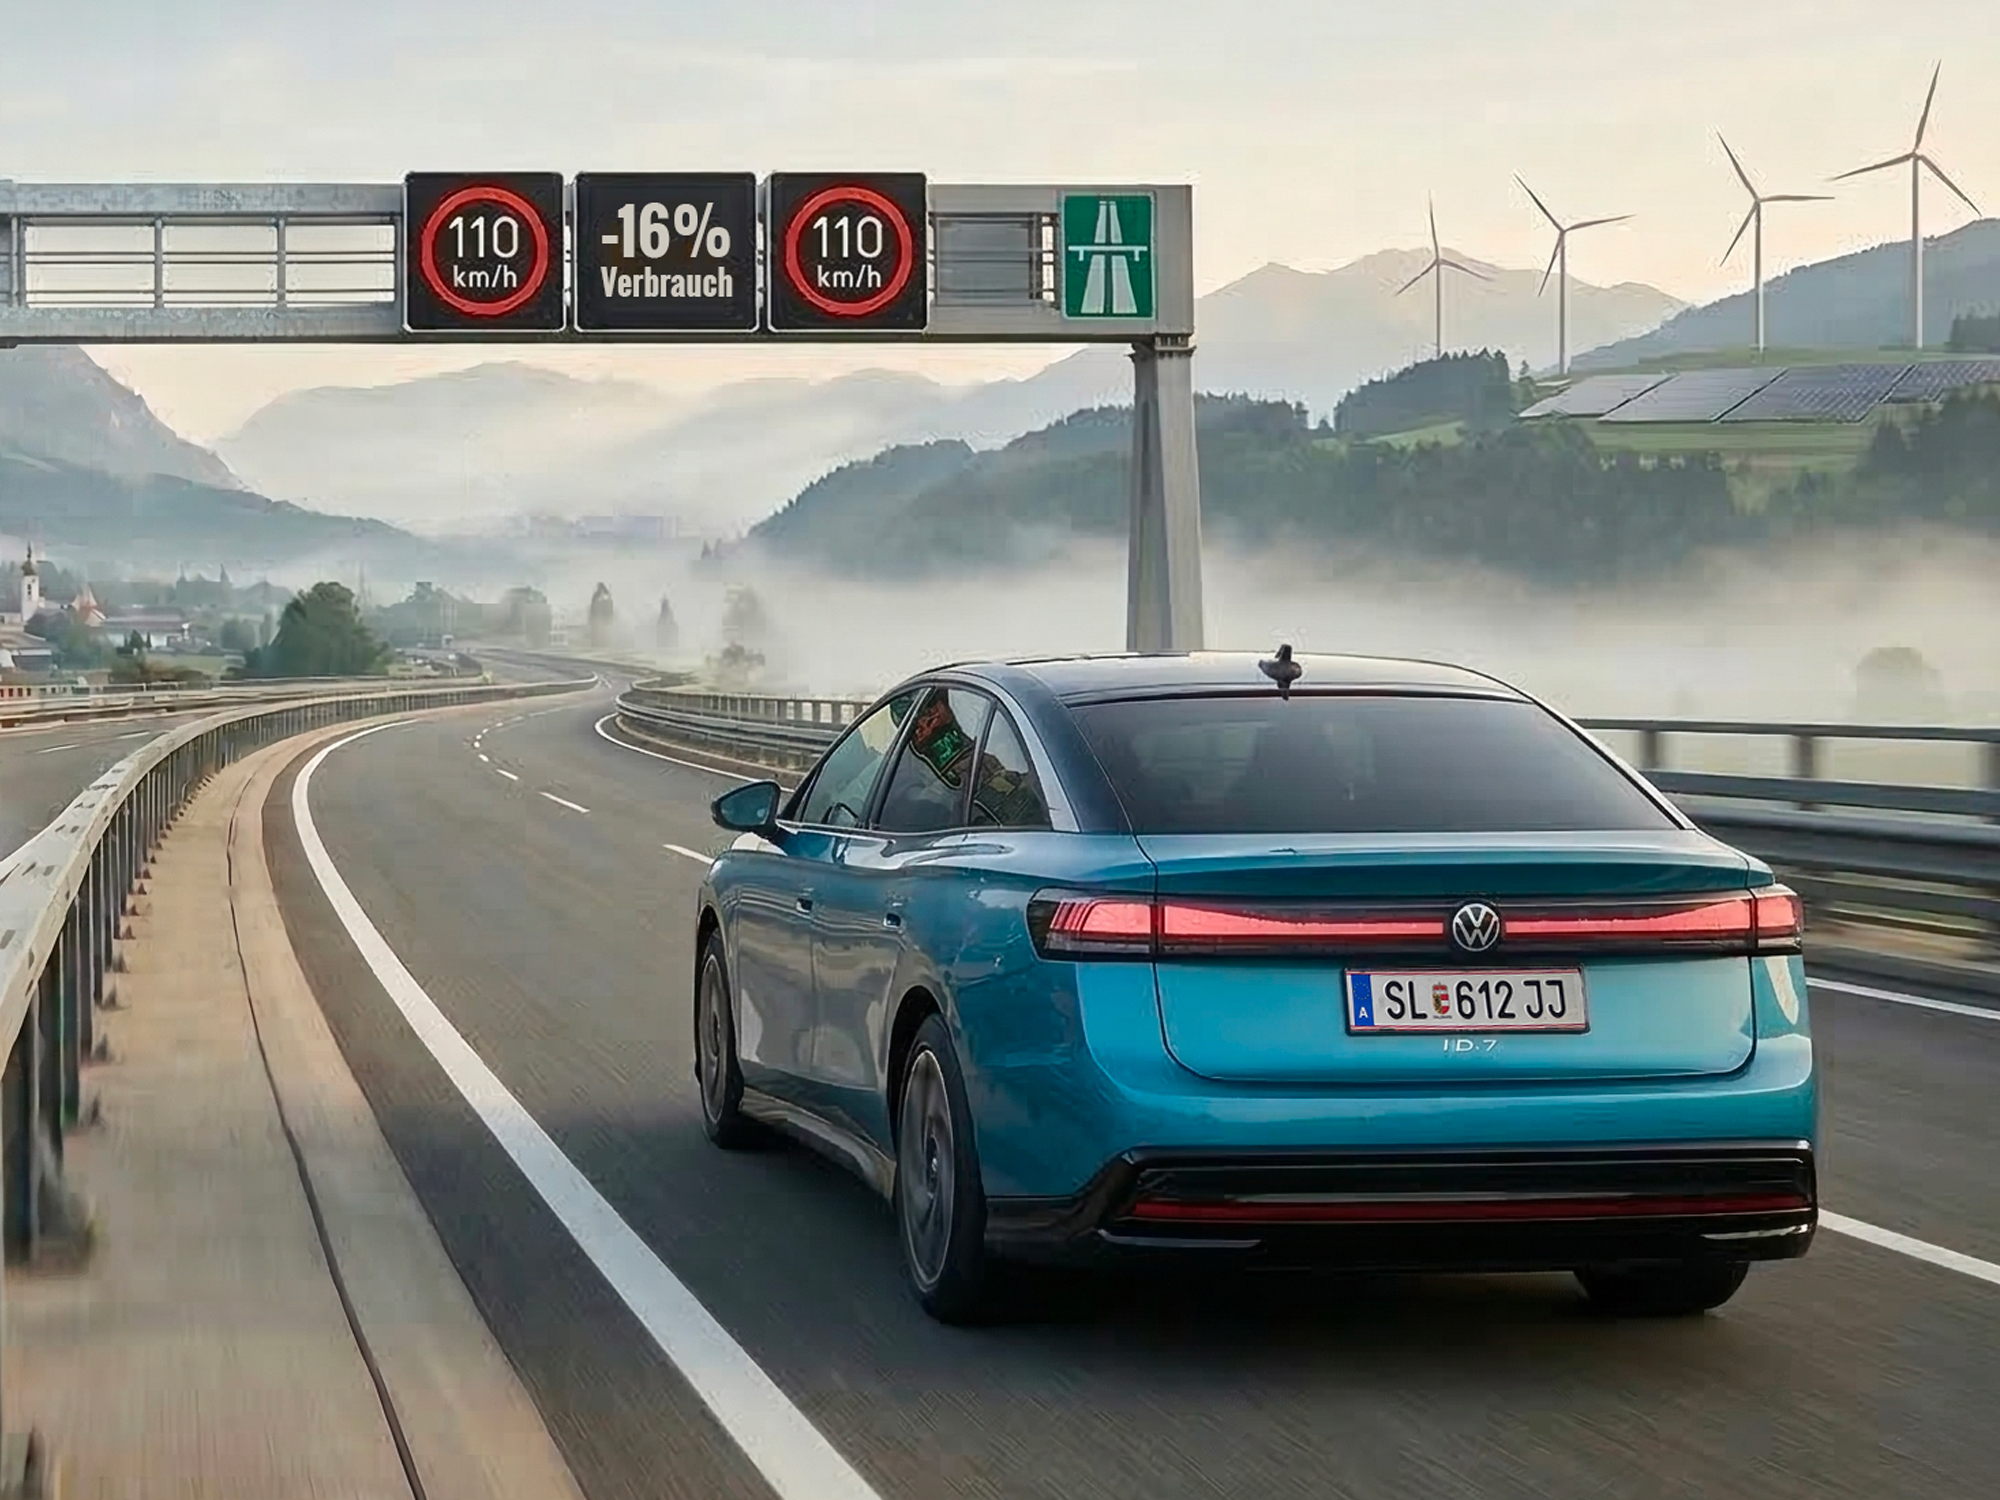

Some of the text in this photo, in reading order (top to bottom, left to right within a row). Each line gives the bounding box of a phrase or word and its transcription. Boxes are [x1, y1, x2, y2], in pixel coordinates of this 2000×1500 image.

[448, 215, 519, 258] 110
[601, 202, 731, 259] -16%
[812, 215, 883, 258] 110
[453, 264, 517, 289] km/h
[600, 265, 734, 298] Verbrauch
[817, 264, 881, 289] km/h
[1358, 1006, 1369, 1019] A
[1384, 979, 1567, 1020] SL 612 JJ
